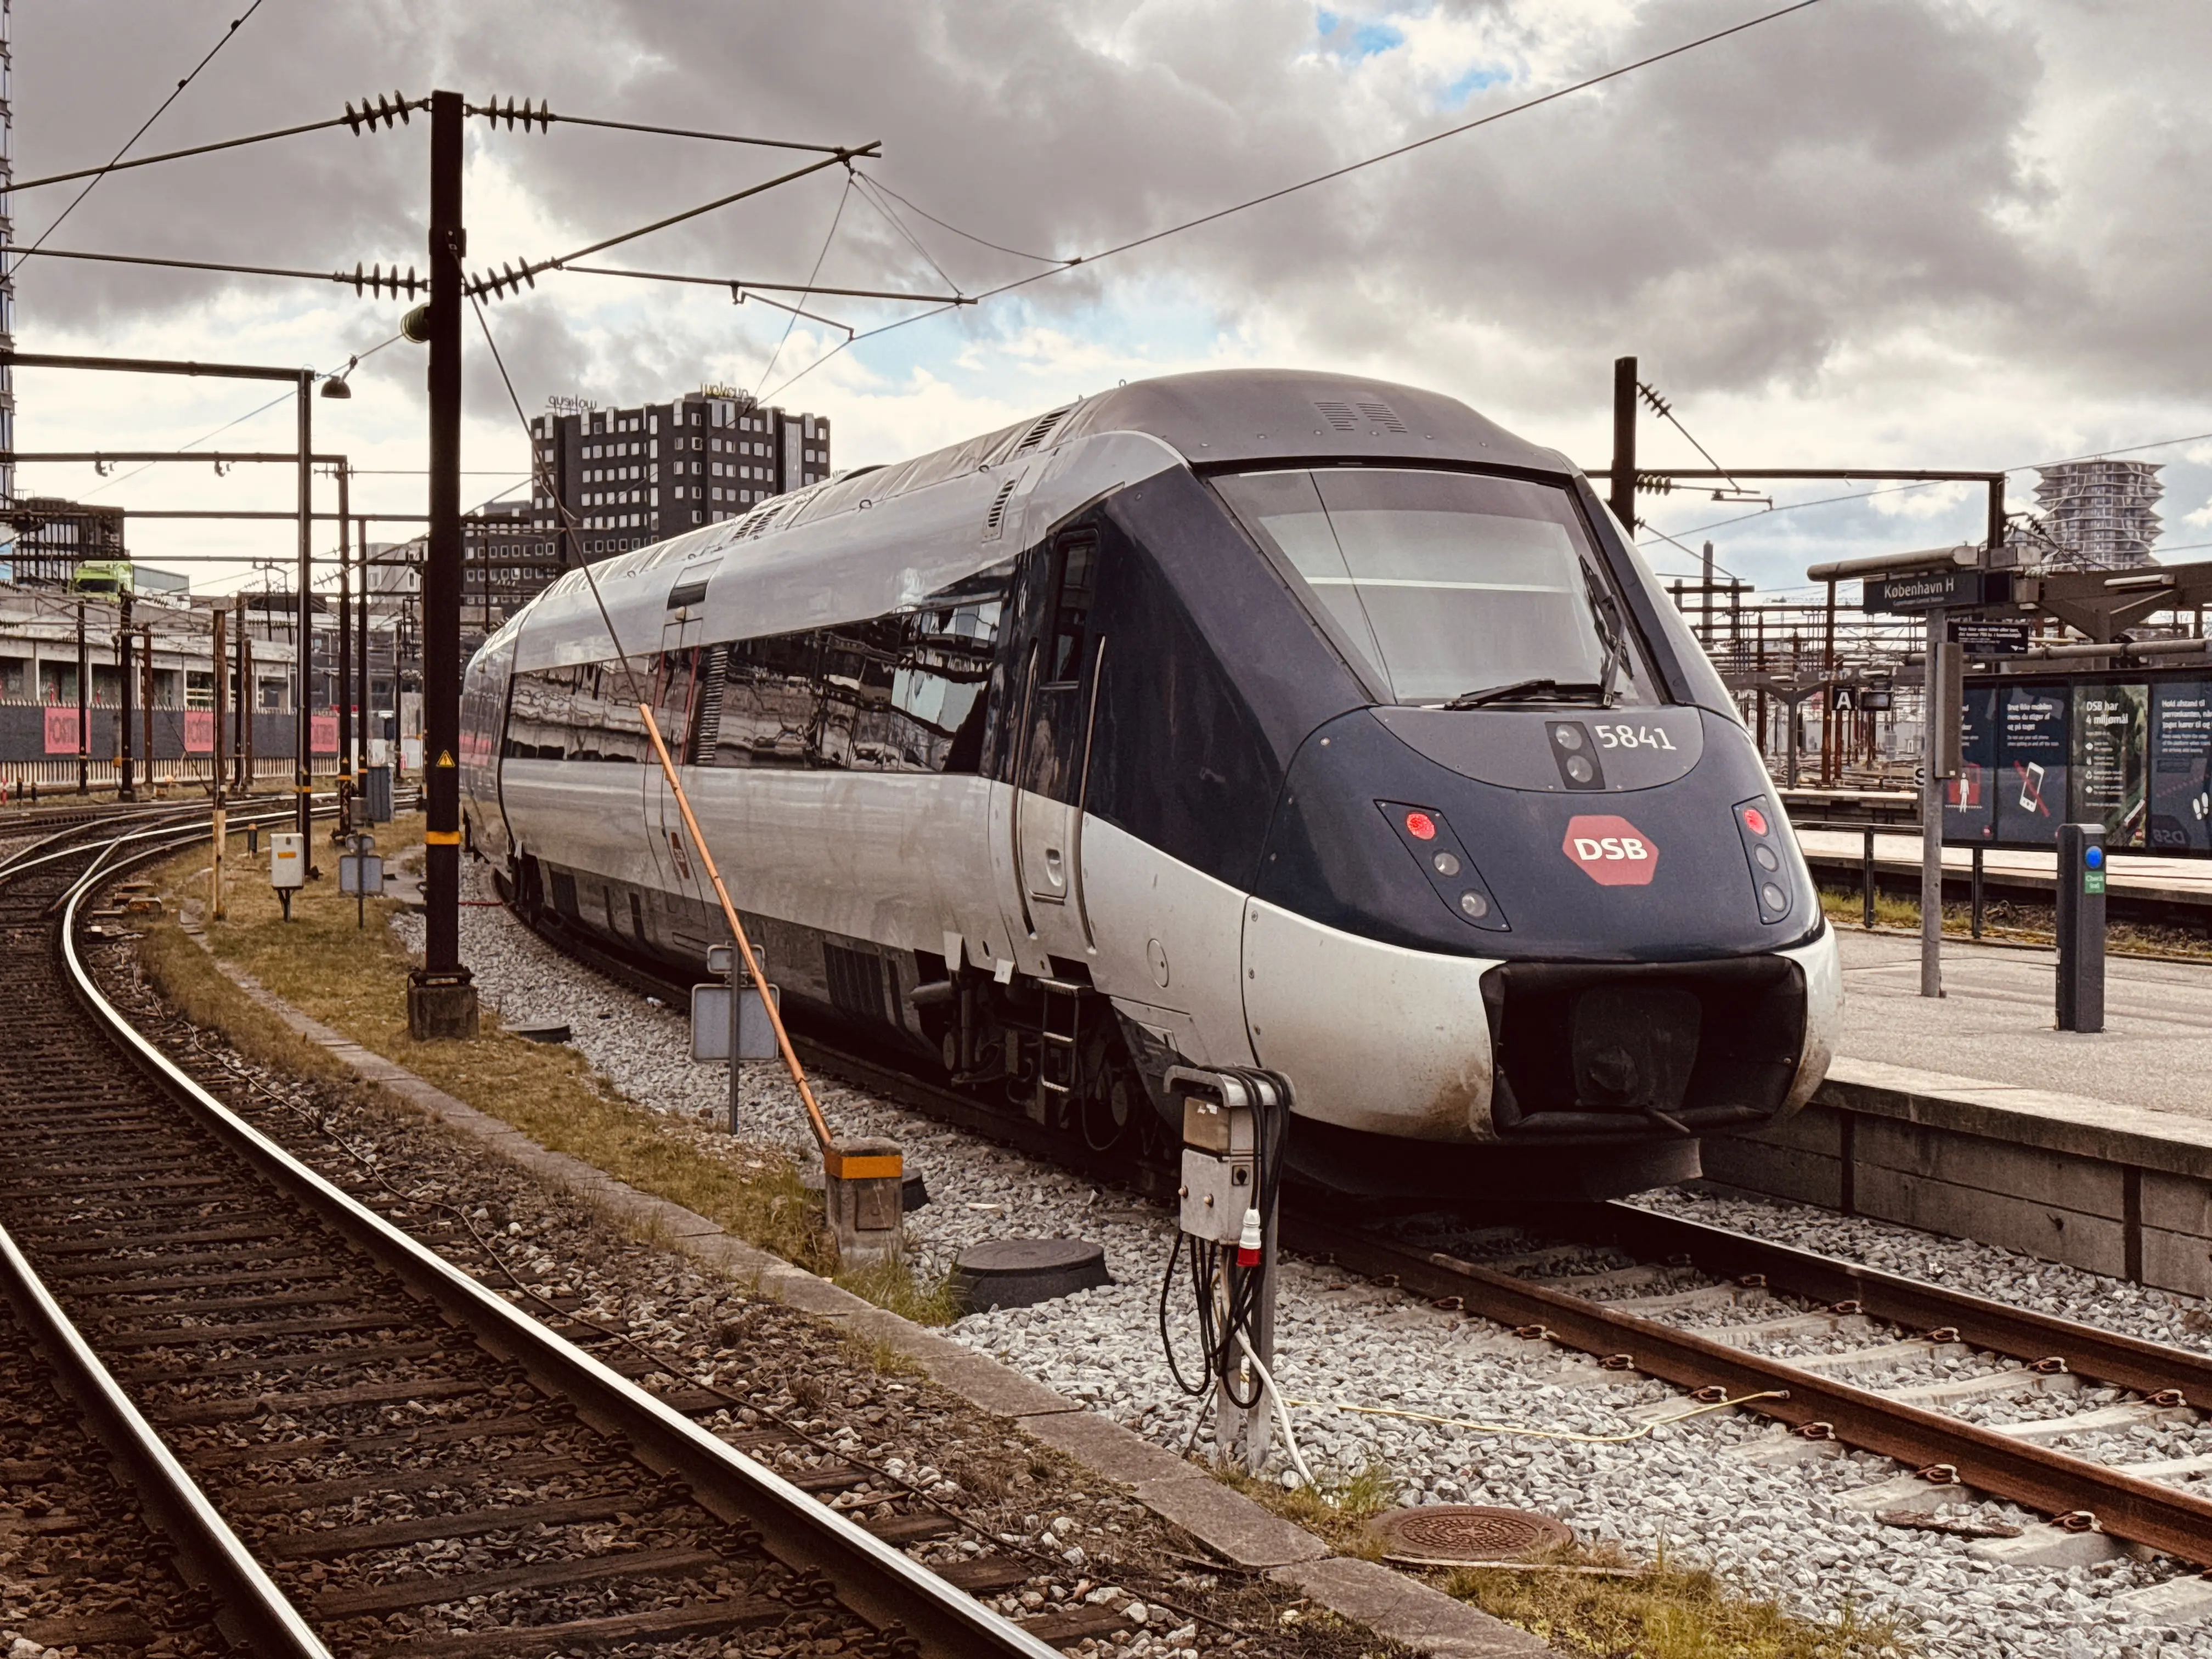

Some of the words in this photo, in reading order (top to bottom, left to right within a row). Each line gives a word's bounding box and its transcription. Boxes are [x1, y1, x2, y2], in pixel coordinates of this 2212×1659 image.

[1884, 580, 1942, 599] København
[1946, 577, 1954, 592] H
[1836, 692, 1852, 709] A
[2086, 701, 2102, 712] DSB
[2104, 700, 2119, 711] har
[2086, 714, 2092, 725] 4
[2094, 713, 2129, 726] miljømål
[1594, 725, 1677, 750] 5841
[1573, 838, 1647, 860] DSB
